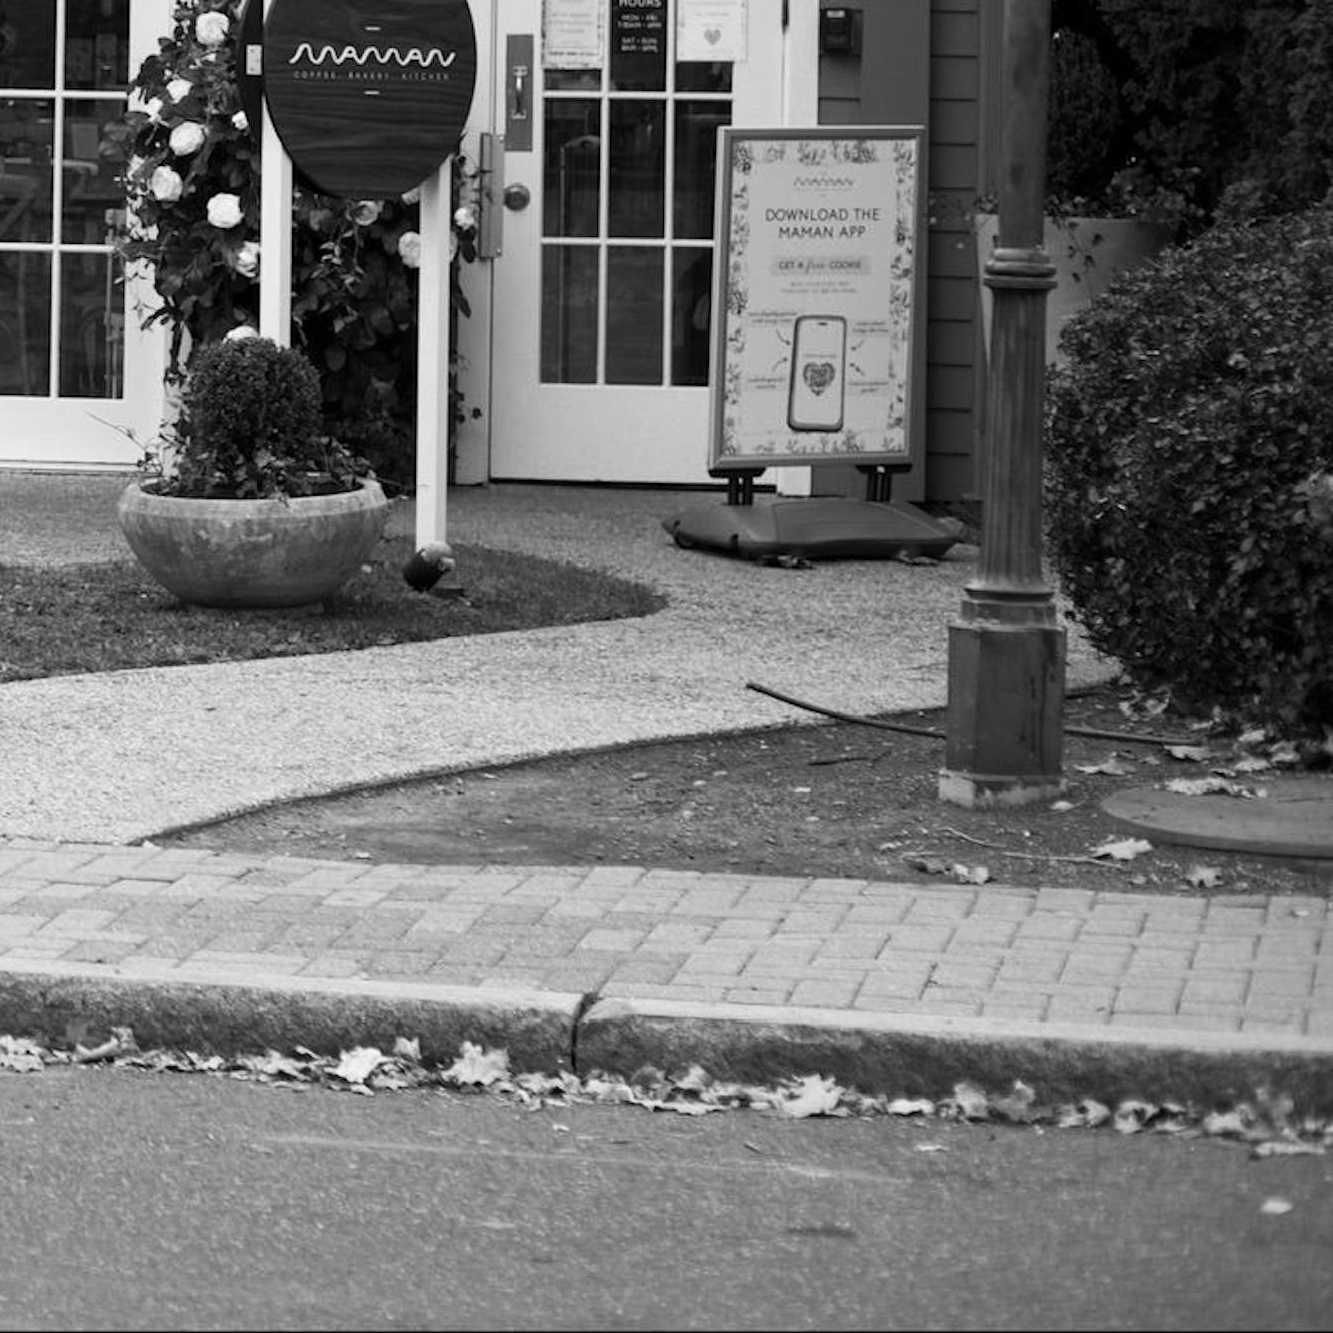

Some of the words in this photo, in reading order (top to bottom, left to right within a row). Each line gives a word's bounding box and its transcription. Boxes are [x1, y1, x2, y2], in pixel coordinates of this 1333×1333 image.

[765, 208, 849, 221] DOWNLOAD
[854, 208, 882, 221] THE
[778, 226, 834, 239] MAMAN
[839, 226, 867, 238] APP
